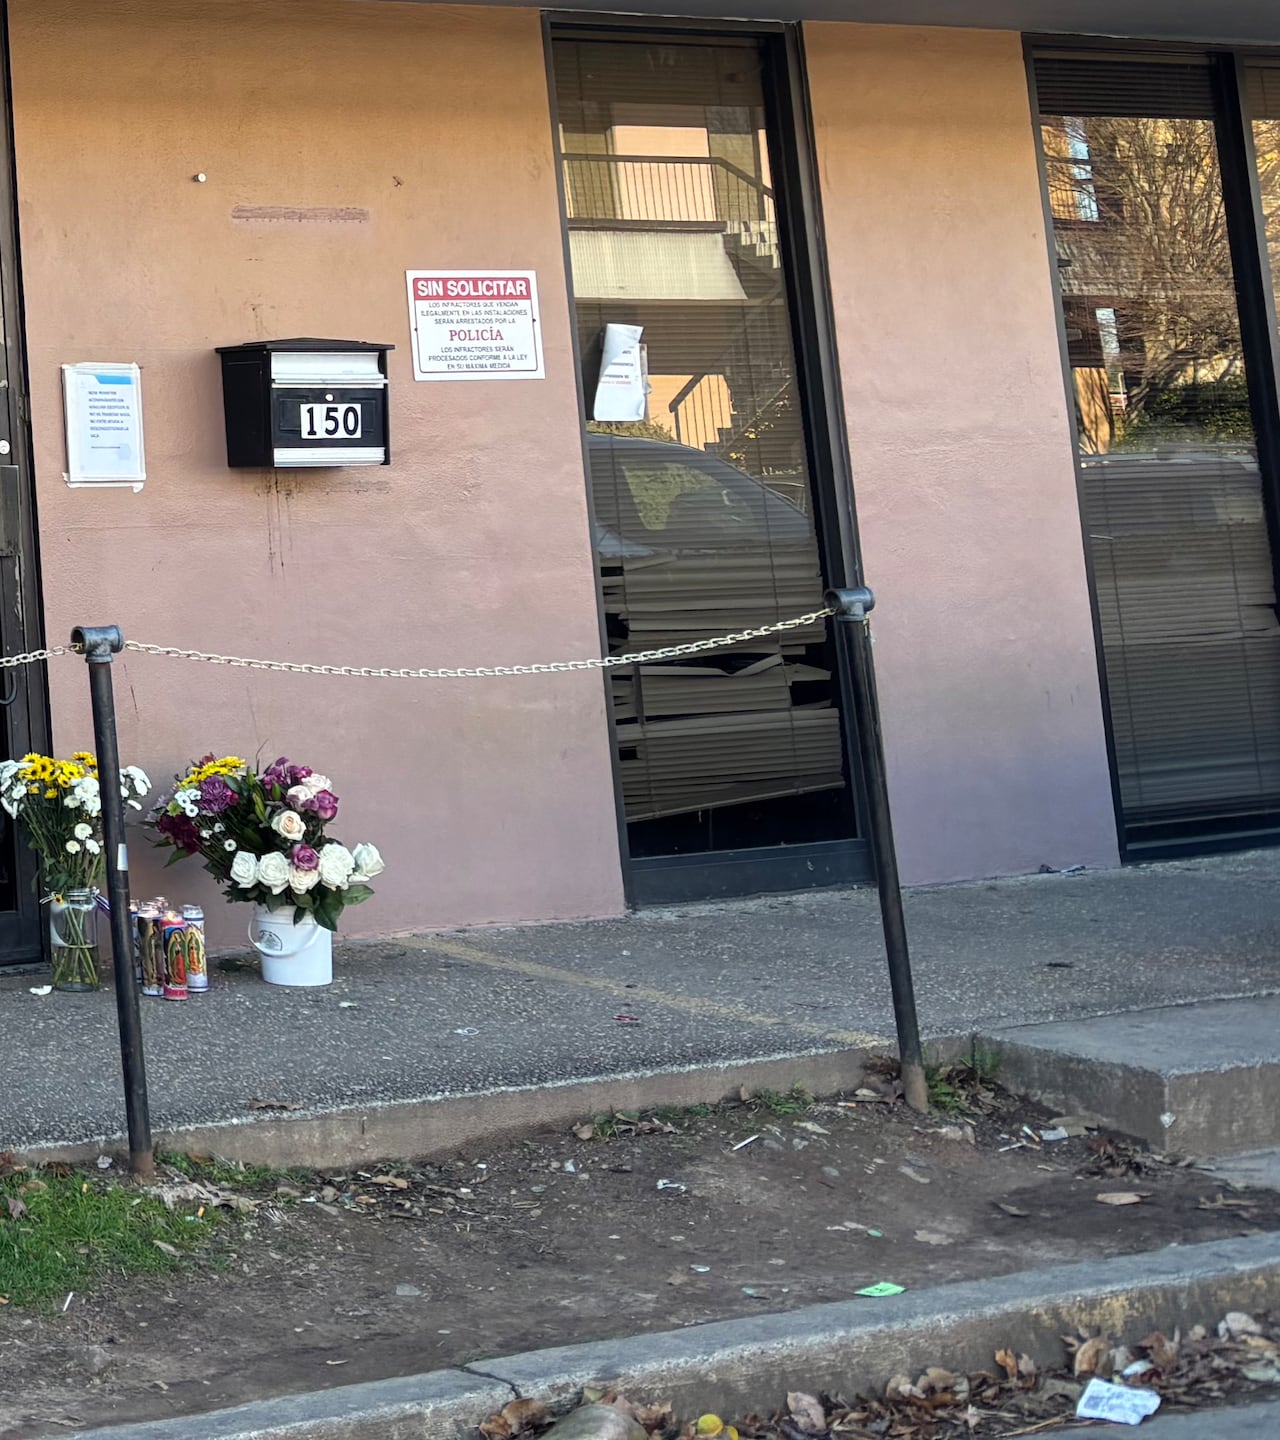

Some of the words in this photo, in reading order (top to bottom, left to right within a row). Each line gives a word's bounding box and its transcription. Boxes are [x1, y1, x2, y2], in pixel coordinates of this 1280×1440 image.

[417, 280, 443, 296] SIN
[447, 280, 527, 296] SOLICITAR
[448, 326, 504, 341] POLICÍA
[307, 406, 359, 436] 150
